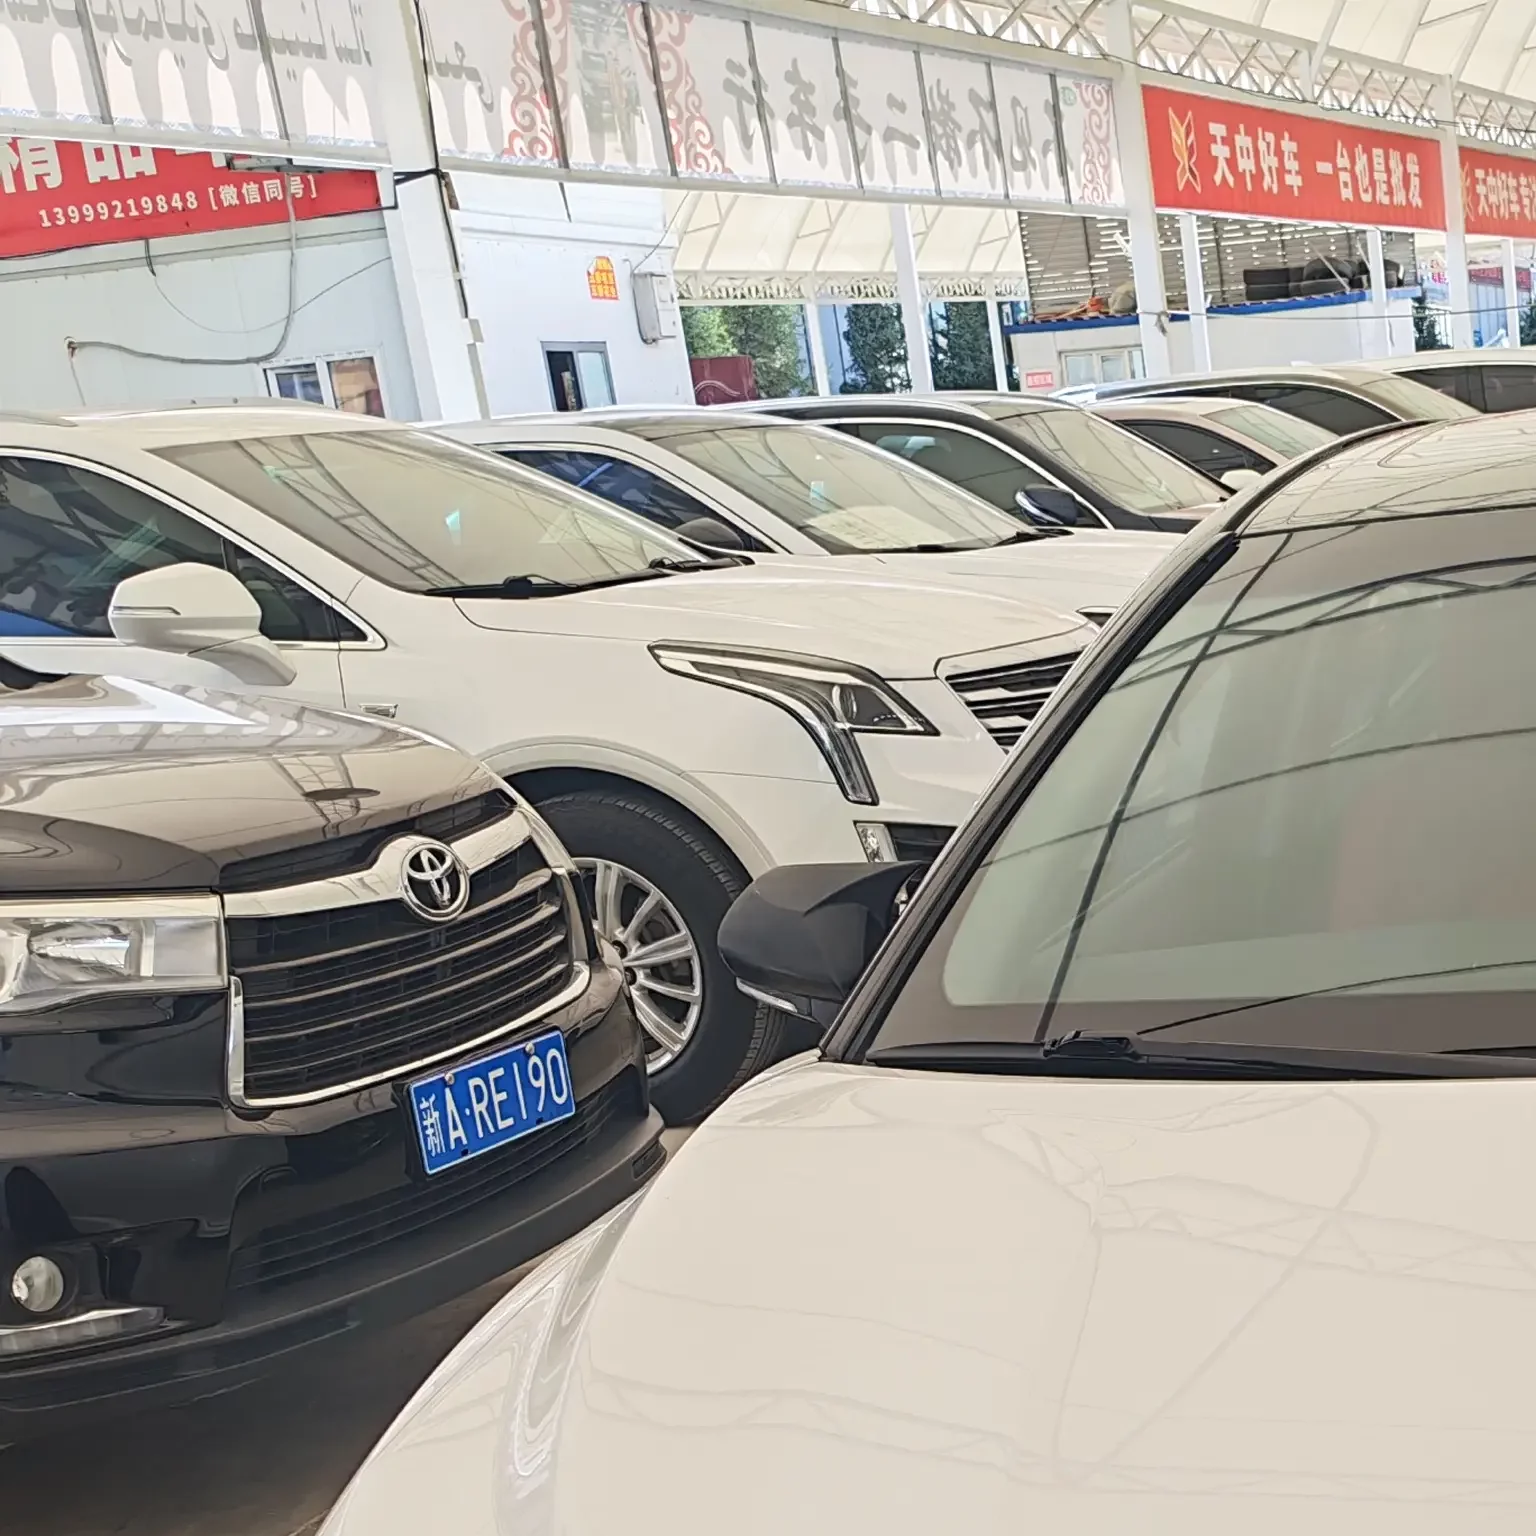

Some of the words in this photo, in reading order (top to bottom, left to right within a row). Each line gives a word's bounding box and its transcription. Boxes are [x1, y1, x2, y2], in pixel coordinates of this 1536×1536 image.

[39, 189, 199, 228] 13999219848
[1208, 122, 1303, 197] 天中好车
[1315, 140, 1422, 209] 一台也是批发
[420, 1048, 568, 1157] 新A·RE190
